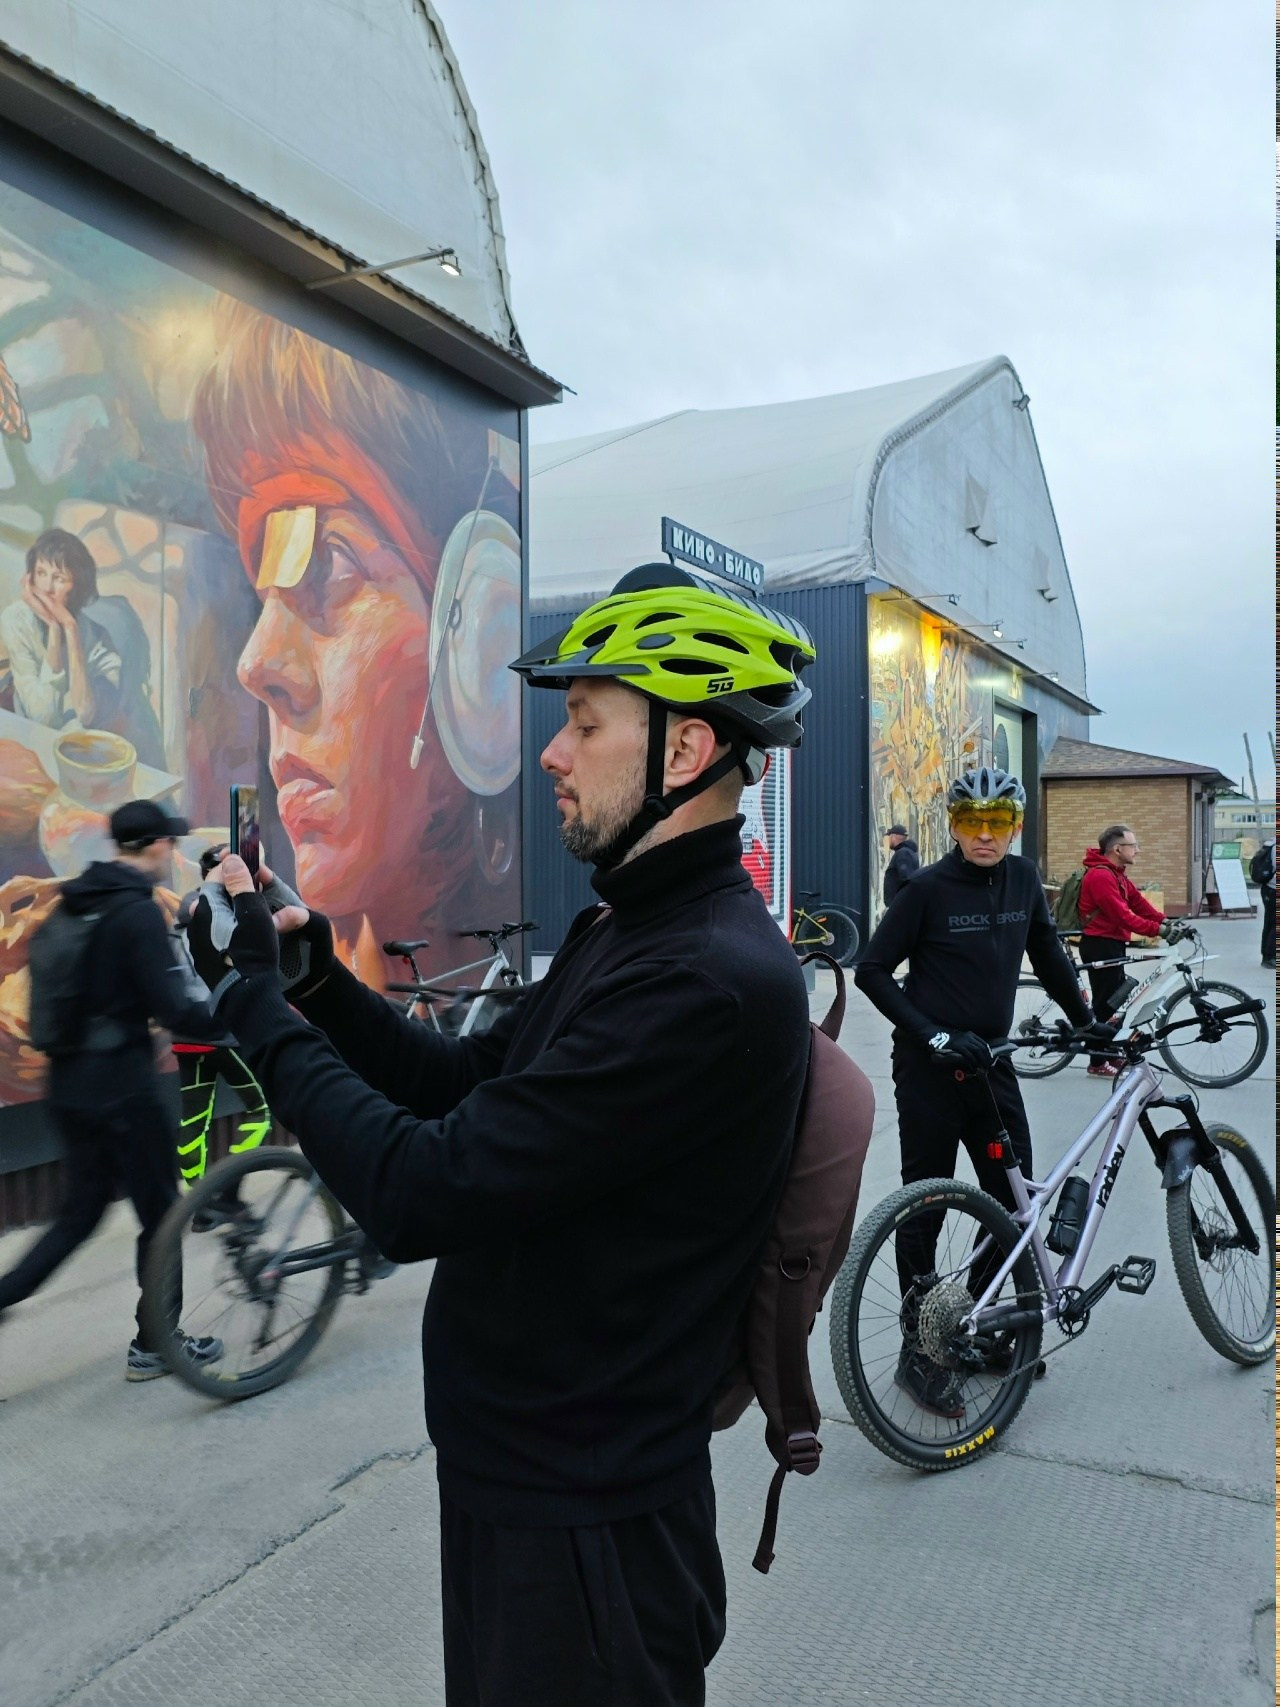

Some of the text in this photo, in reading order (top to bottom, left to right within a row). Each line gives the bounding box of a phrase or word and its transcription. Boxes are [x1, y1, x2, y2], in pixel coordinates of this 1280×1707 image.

[672, 526, 715, 564] КИНО
[948, 910, 1026, 927] ROCK BROS
[945, 1426, 995, 1458] MAXXIS
